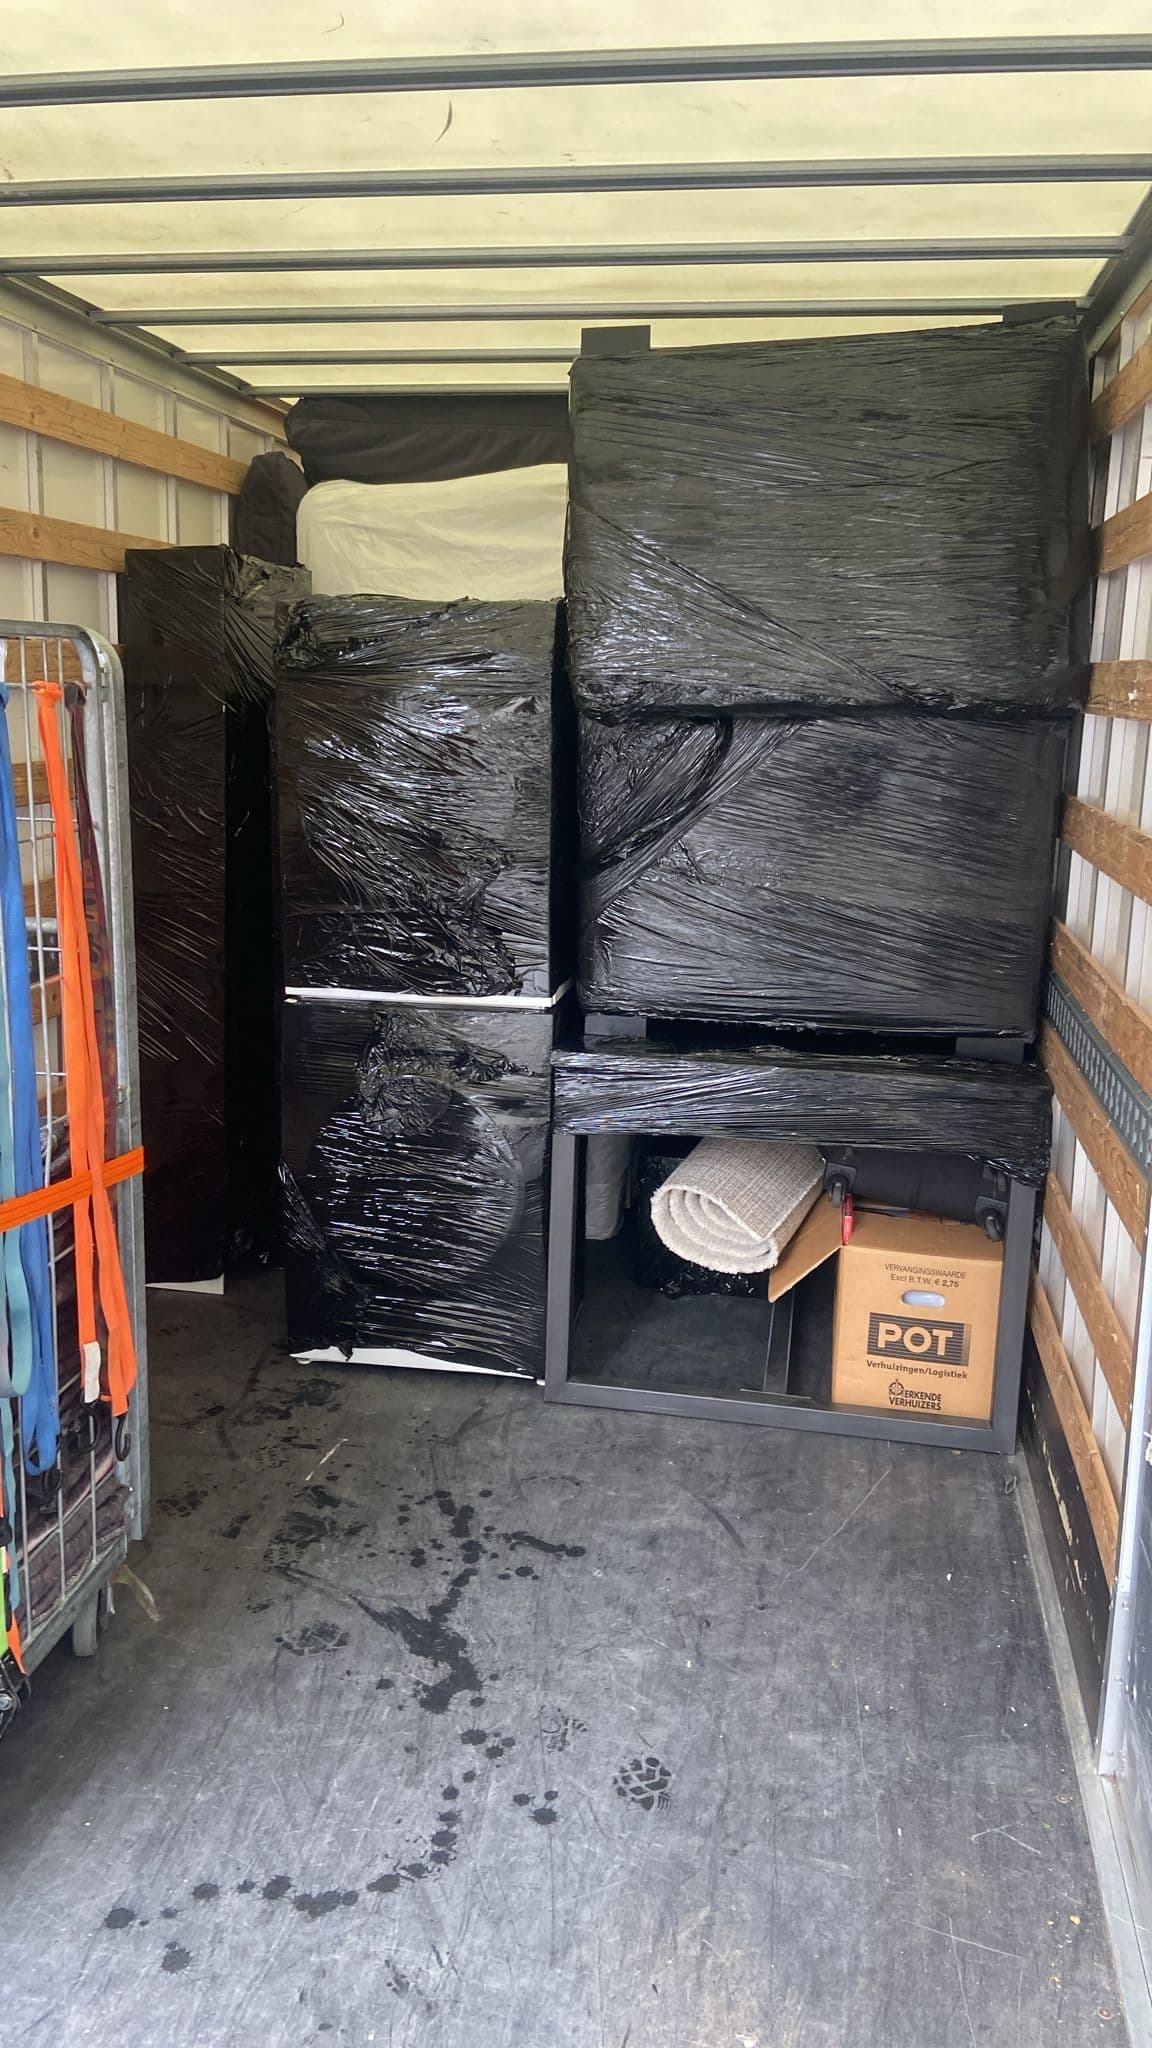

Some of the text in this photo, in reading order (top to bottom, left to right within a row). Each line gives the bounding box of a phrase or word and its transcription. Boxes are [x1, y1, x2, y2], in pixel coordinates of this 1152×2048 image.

[884, 1263, 967, 1279] VERVANGINGSWAARDE
[890, 1273, 907, 1282] Excl
[934, 1278, 941, 1286] €
[941, 1279, 960, 1288] 2,75
[877, 1321, 954, 1356] POT
[866, 1359, 968, 1380] Verhuizingen/Logistiek
[904, 1389, 943, 1402] ERKENDE
[888, 1396, 942, 1411] VERHUIZERS
